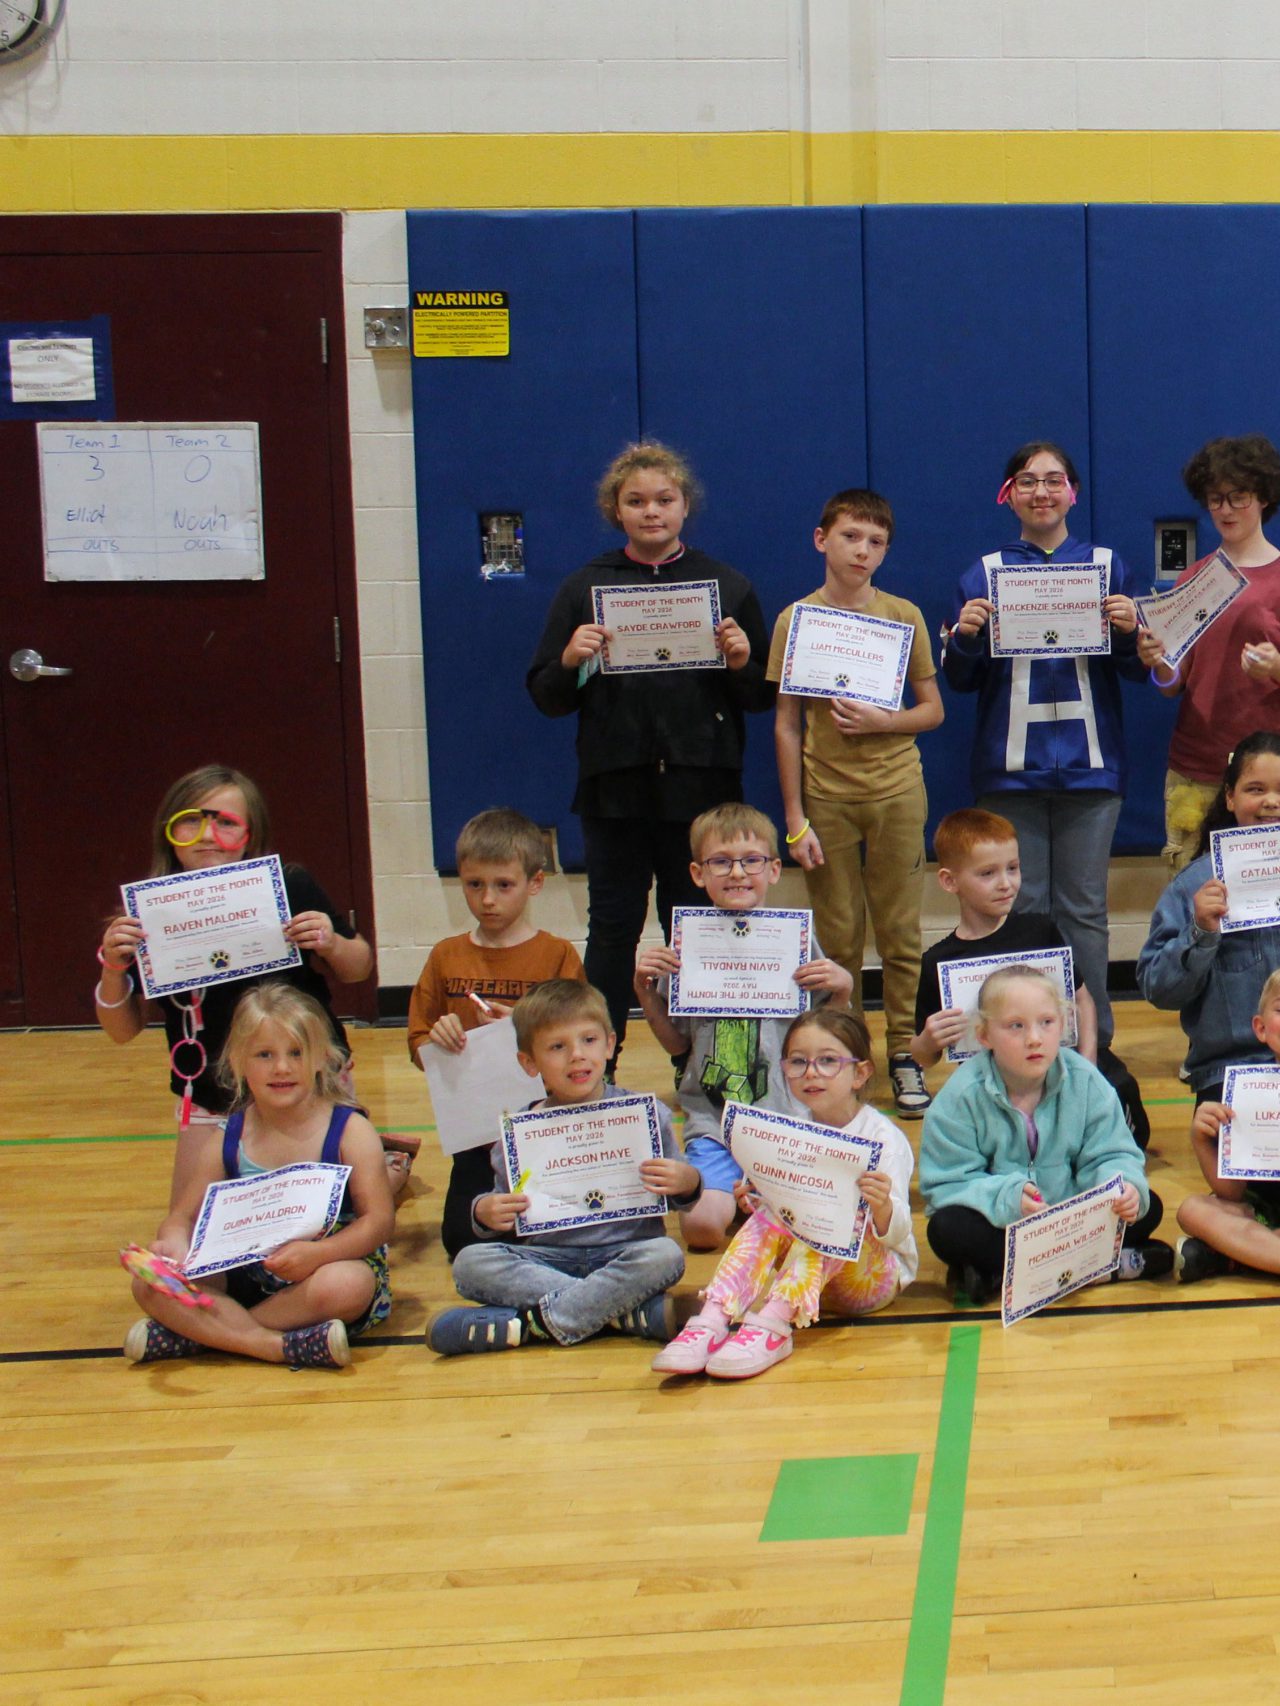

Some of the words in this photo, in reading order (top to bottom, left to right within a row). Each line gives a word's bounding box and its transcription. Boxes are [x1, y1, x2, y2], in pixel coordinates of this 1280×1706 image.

[417, 293, 503, 305] WARNING
[66, 435, 104, 448] Team
[109, 435, 121, 448] 1
[166, 435, 208, 447] Team
[216, 435, 232, 447] 2
[85, 455, 105, 481] 3
[676, 596, 704, 604] MONTH
[1002, 604, 1049, 612] MACKENZIE
[1052, 602, 1097, 610] SCHRADER
[618, 624, 648, 632] SAYDE
[650, 621, 701, 630] CRAWFORD
[808, 619, 842, 630] STUDENT
[855, 627, 869, 635] THE
[871, 630, 896, 641] MONTH
[811, 642, 832, 652] LIAM
[1229, 841, 1265, 852] STUDENT
[146, 891, 191, 907] STUDENT
[194, 888, 205, 897] OF
[208, 884, 228, 894] THE
[229, 877, 263, 889] MONTH
[164, 920, 202, 935] RAVEN
[205, 908, 257, 926] MALONEY
[701, 962, 747, 970] RANDALL
[750, 963, 780, 971] GAVIN
[524, 1125, 570, 1140] STUDENT
[572, 1123, 585, 1132] OF
[588, 1120, 606, 1129] THE
[608, 1115, 640, 1127] MONTH
[566, 1135, 583, 1143] MAY
[586, 1132, 604, 1140] 2026
[742, 1126, 787, 1145] STUDENT
[789, 1138, 800, 1148] OF
[805, 1142, 823, 1153] THE
[825, 1147, 860, 1164] MONTH
[546, 1153, 598, 1170] JACKSON
[600, 1148, 631, 1162] MAYE
[778, 1148, 795, 1158] MAY
[798, 1153, 817, 1163] 2026
[753, 1162, 787, 1180] QUINN
[788, 1173, 834, 1191] NICOSIA
[222, 1189, 261, 1205] STUDENT
[261, 1185, 273, 1194] OF
[275, 1179, 290, 1189] THE
[291, 1177, 325, 1187] MONTH
[223, 1216, 253, 1231] QUINN
[256, 1205, 307, 1222] WALDRON
[1024, 1220, 1060, 1242] STUDENT
[1062, 1215, 1070, 1226] OF
[1074, 1210, 1087, 1220] THE
[1089, 1198, 1116, 1213] MONTH
[1028, 1242, 1070, 1266] MCKENNA
[1074, 1224, 1106, 1246] WILSON
